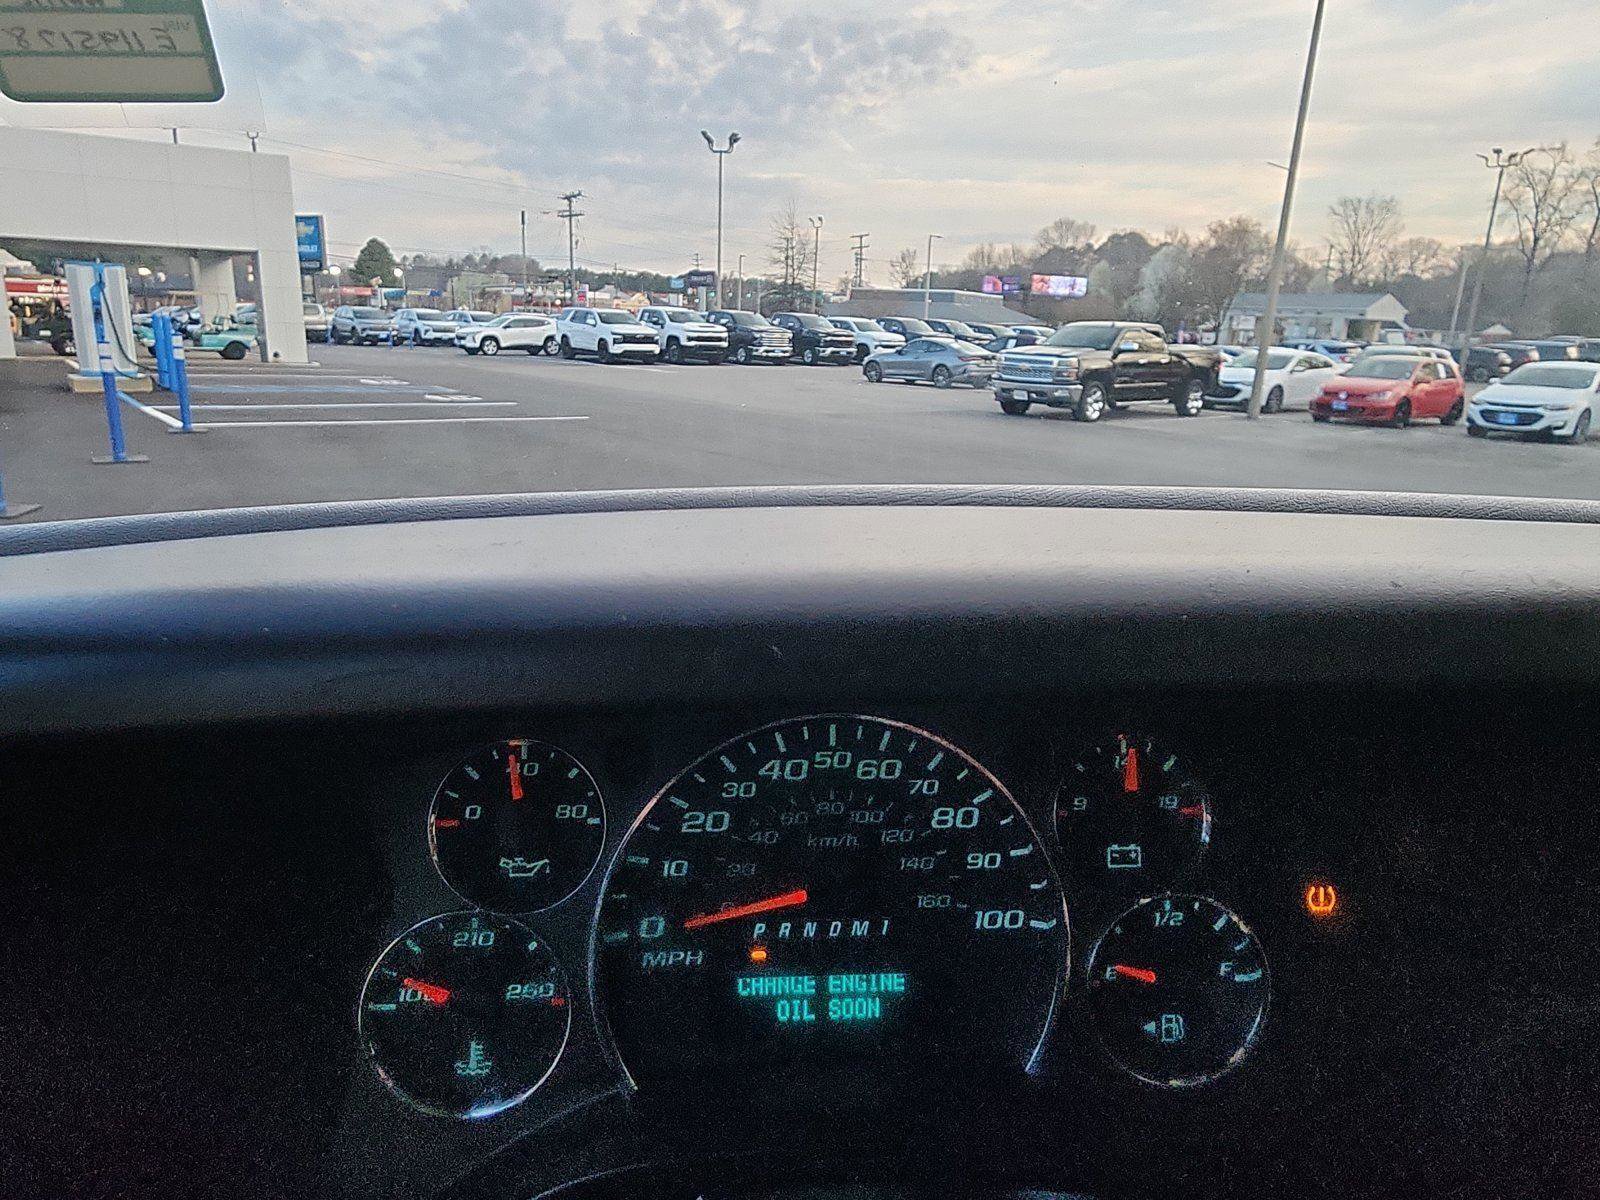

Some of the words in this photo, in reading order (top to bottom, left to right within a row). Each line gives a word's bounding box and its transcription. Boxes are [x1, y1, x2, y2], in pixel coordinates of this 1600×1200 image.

[814, 751, 852, 769] 50
[758, 759, 809, 781] 40
[856, 759, 902, 780] 60
[721, 781, 757, 799] 30
[909, 779, 940, 795] 70
[465, 805, 482, 819] 0
[555, 804, 588, 819] 80
[1073, 796, 1088, 811] 9
[680, 811, 731, 833] 20
[930, 807, 980, 829] 80
[880, 829, 915, 844] 120
[661, 860, 689, 877] 10
[900, 857, 936, 871] 140
[966, 853, 1002, 870] 90
[639, 916, 665, 939] 0
[974, 910, 1025, 930] 100
[1153, 911, 1186, 927] 1/2
[753, 922, 767, 939] P
[803, 921, 818, 938] N
[851, 920, 870, 937] M
[452, 931, 496, 947] 210
[641, 950, 704, 968] MPH
[736, 975, 816, 997] CHANGE
[828, 973, 906, 993] ENGINE
[776, 998, 816, 1022] OIL
[828, 997, 881, 1020] SOON
